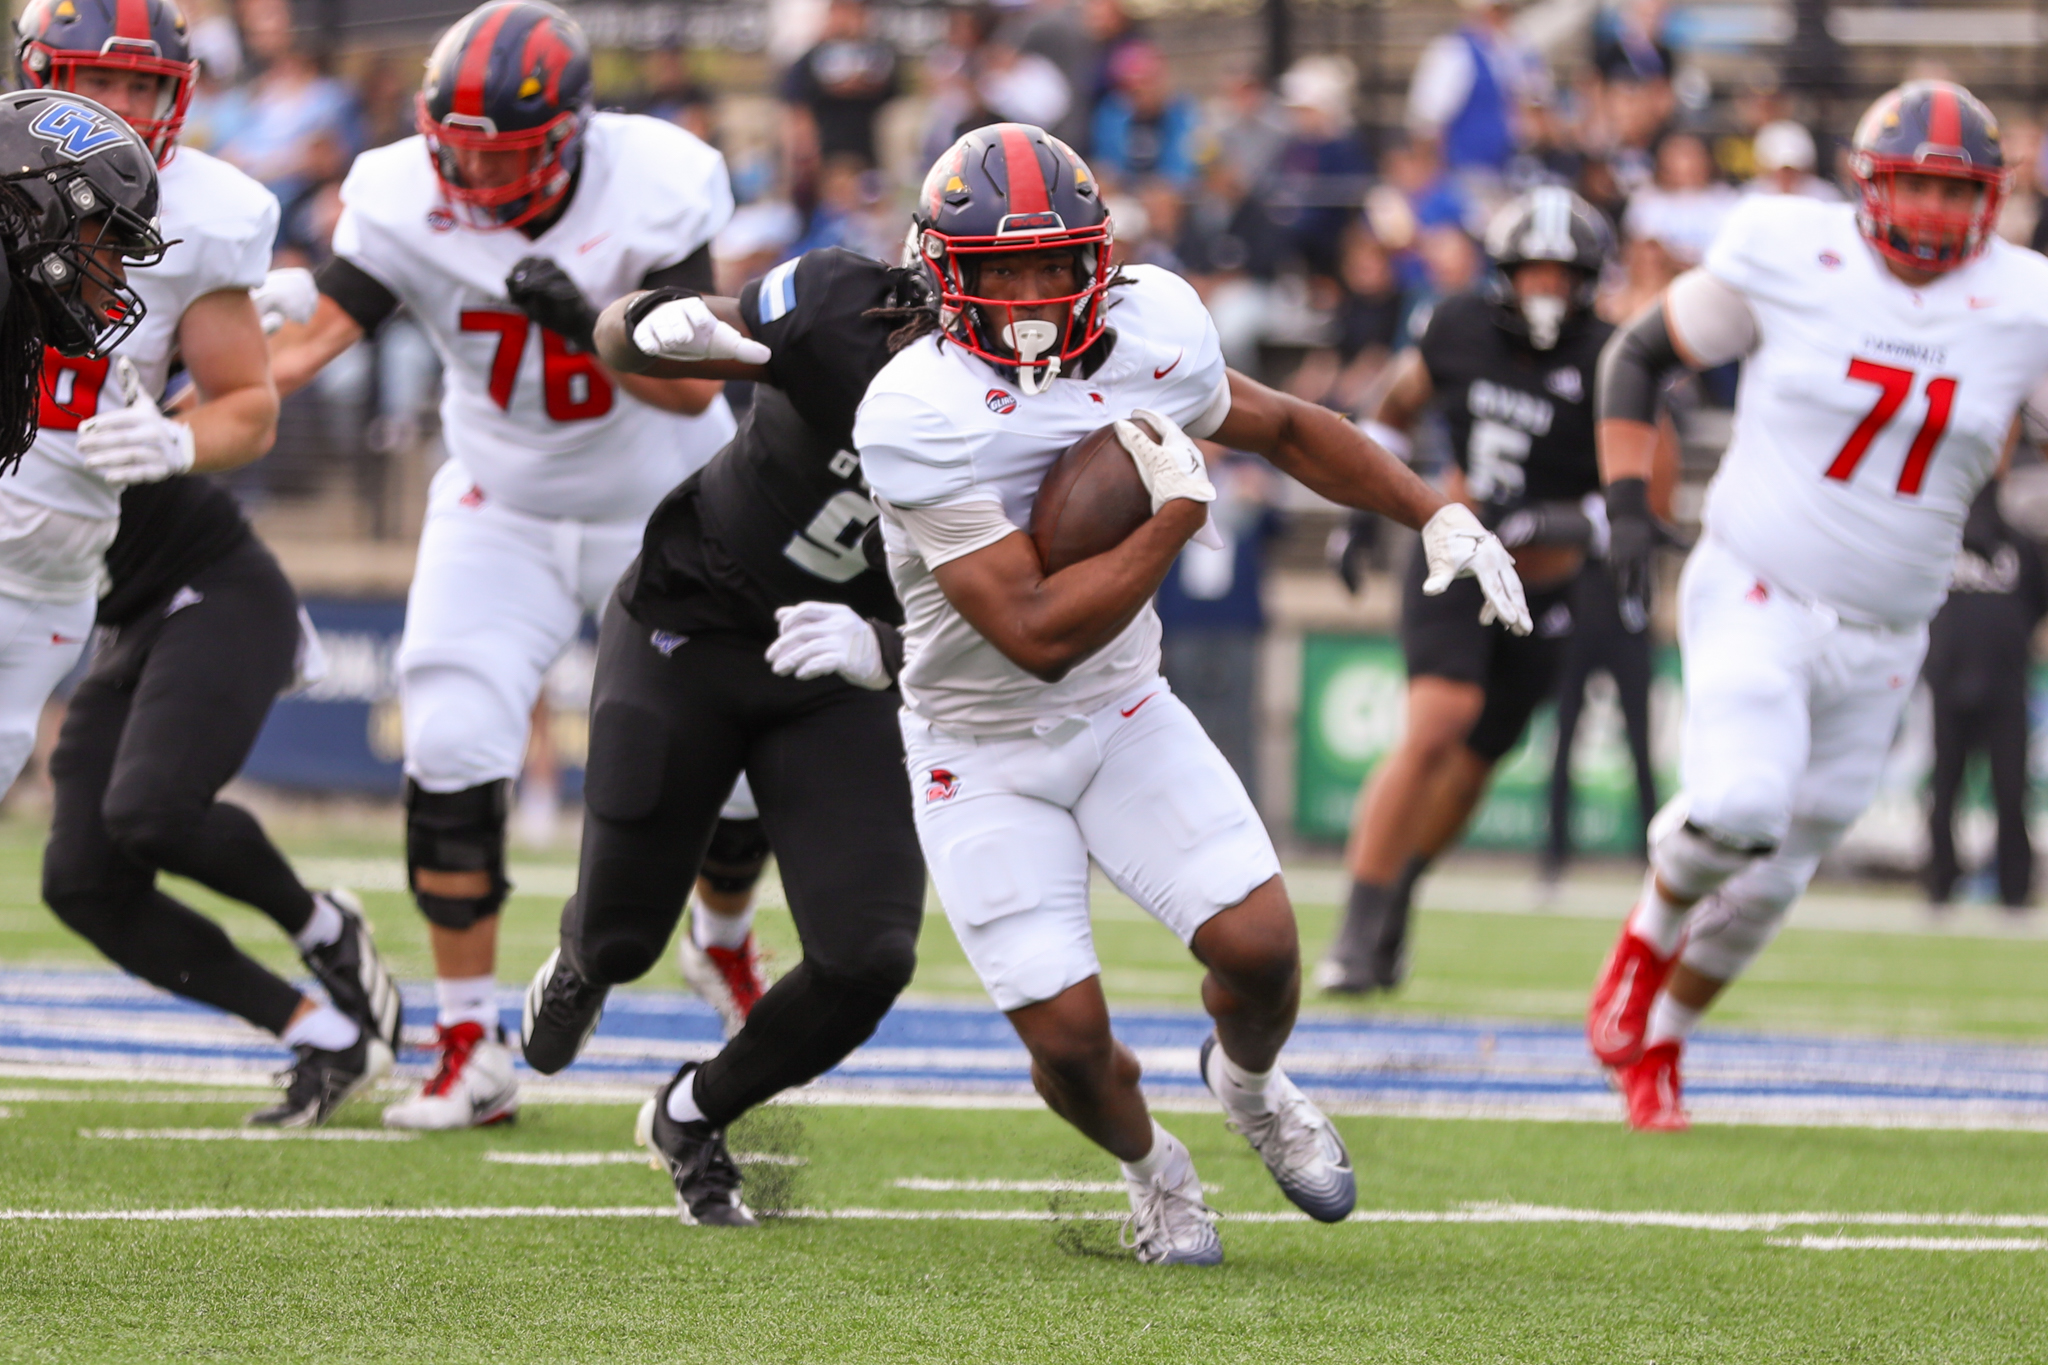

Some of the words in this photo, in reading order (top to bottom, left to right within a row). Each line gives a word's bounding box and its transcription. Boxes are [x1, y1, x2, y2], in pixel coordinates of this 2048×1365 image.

[28, 100, 133, 161] GV
[460, 310, 614, 422] 76
[990, 395, 1015, 411] GLIAC
[1825, 358, 1957, 495] 71
